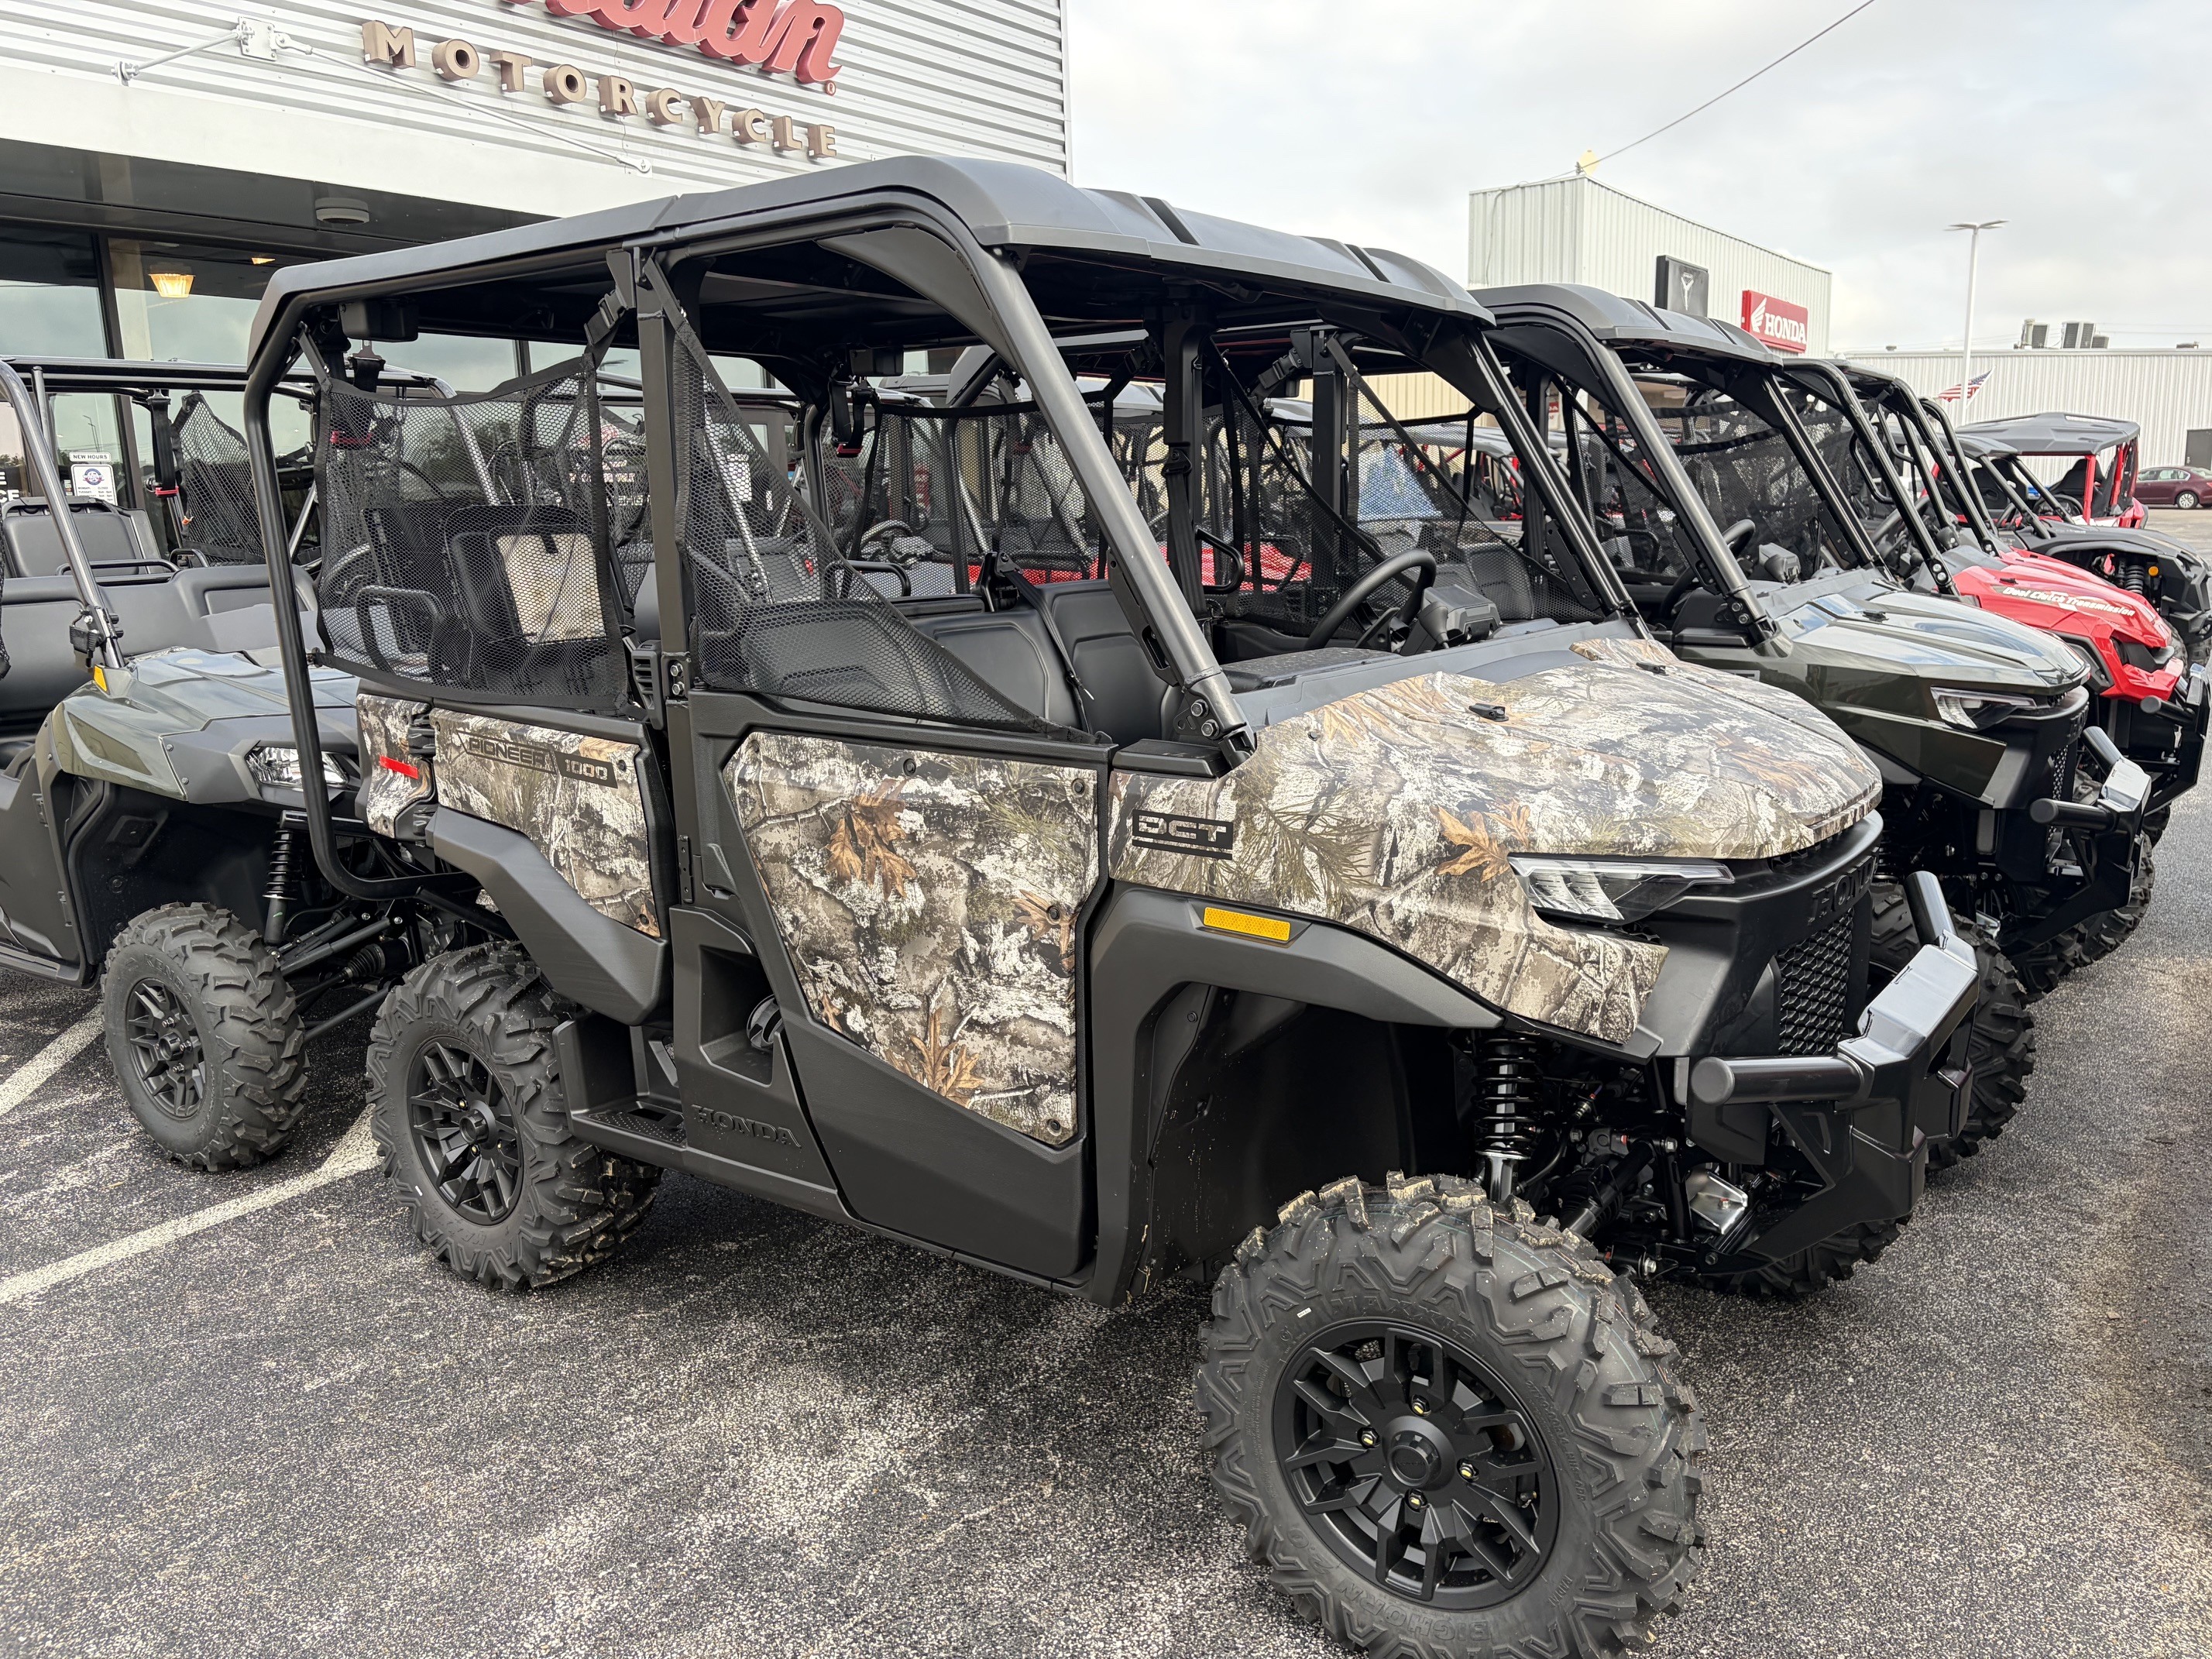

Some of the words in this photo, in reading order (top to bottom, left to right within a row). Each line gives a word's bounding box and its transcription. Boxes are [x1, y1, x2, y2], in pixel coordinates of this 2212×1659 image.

[362, 20, 836, 159] MOTORCYCLE
[1764, 312, 1807, 345] HONDA
[2002, 586, 2031, 598] Dual
[2030, 591, 2066, 603] Clutch
[2066, 596, 2136, 617] Transmission
[469, 737, 546, 766] PIONEER
[565, 759, 609, 781] 1000
[1139, 815, 1227, 843] DCT
[143, 953, 193, 1005] KENDA
[691, 1104, 802, 1149] HONDA
[1328, 1295, 1479, 1341] MAXXIS
[1286, 1527, 1334, 1575] 2.0
[1336, 1577, 1492, 1642] BIGHORN
